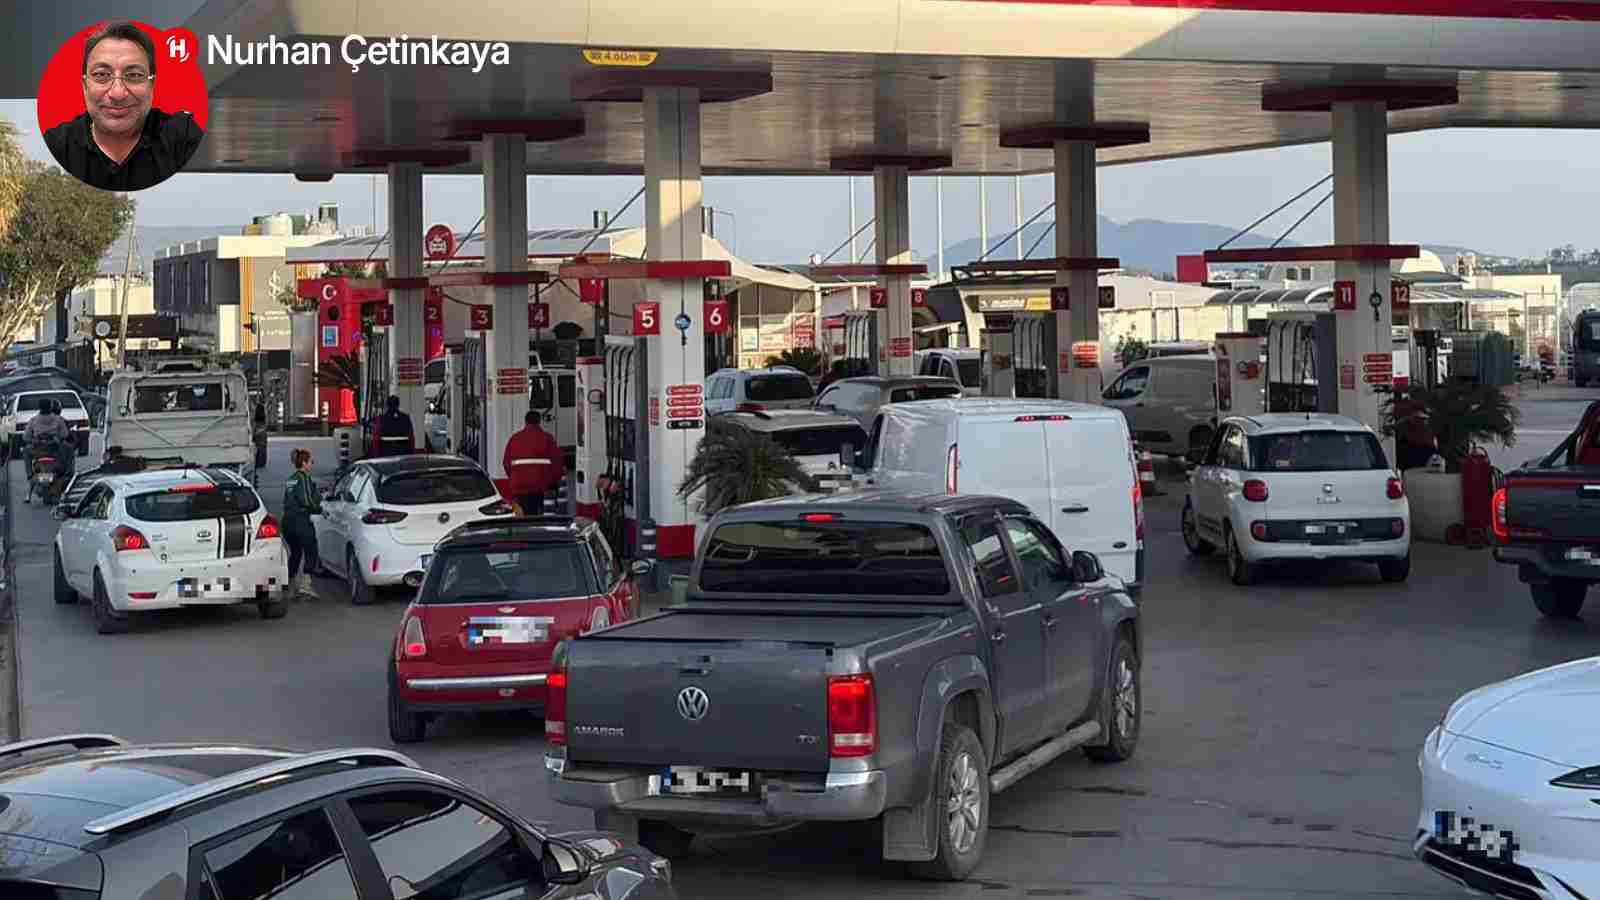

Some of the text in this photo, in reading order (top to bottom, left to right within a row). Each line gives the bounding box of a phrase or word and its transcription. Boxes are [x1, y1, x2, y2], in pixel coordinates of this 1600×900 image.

[875, 292, 883, 304] 7
[1340, 287, 1352, 304] 11
[1394, 286, 1408, 303] 12
[426, 307, 438, 320] 2
[477, 309, 489, 325] 3
[533, 309, 545, 323] 4
[641, 309, 654, 328] 5
[710, 307, 722, 326] 6
[575, 725, 624, 737] AMAROK
